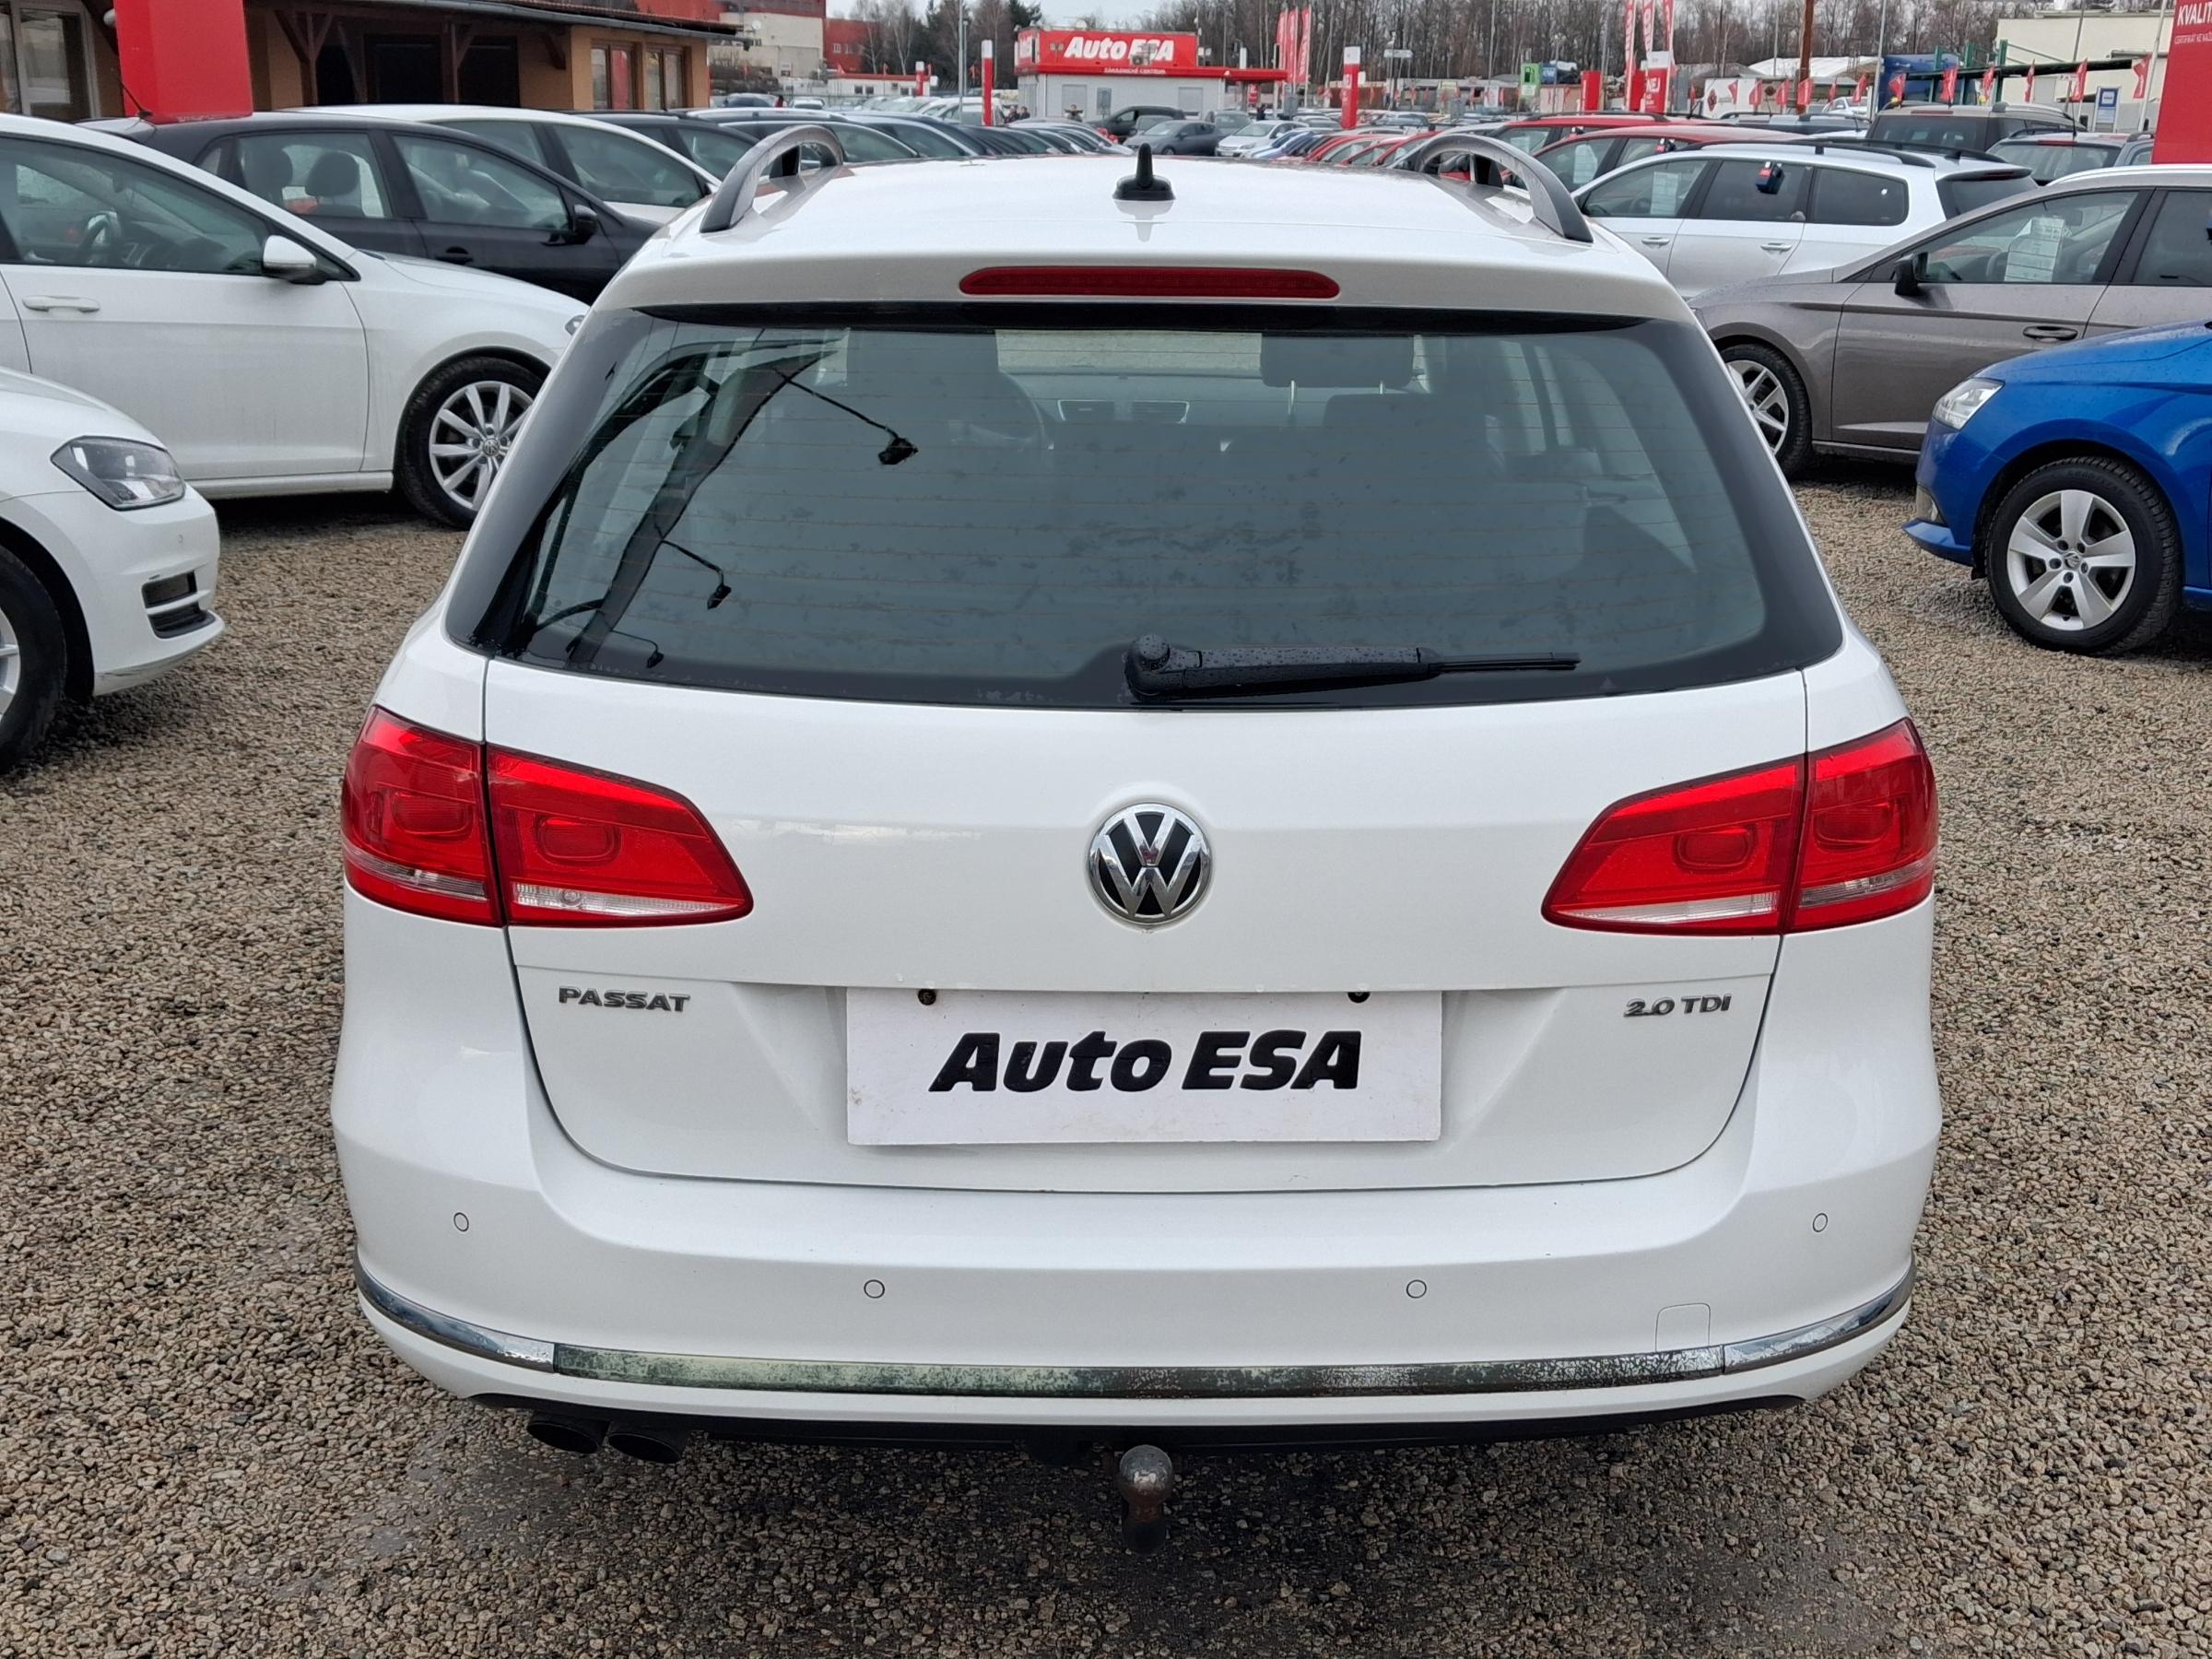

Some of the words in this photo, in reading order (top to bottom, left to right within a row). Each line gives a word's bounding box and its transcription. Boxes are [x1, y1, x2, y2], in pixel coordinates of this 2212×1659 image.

[2177, 1, 2212, 26] KVALIT
[1064, 36, 1127, 59] Auto
[1092, 806, 1207, 922] VW
[559, 985, 690, 1012] PASSAT
[1623, 996, 1676, 1018] 2.0
[1681, 994, 1733, 1014] TDI
[928, 1030, 1172, 1092] Auto
[1182, 1030, 1362, 1090] ESA
